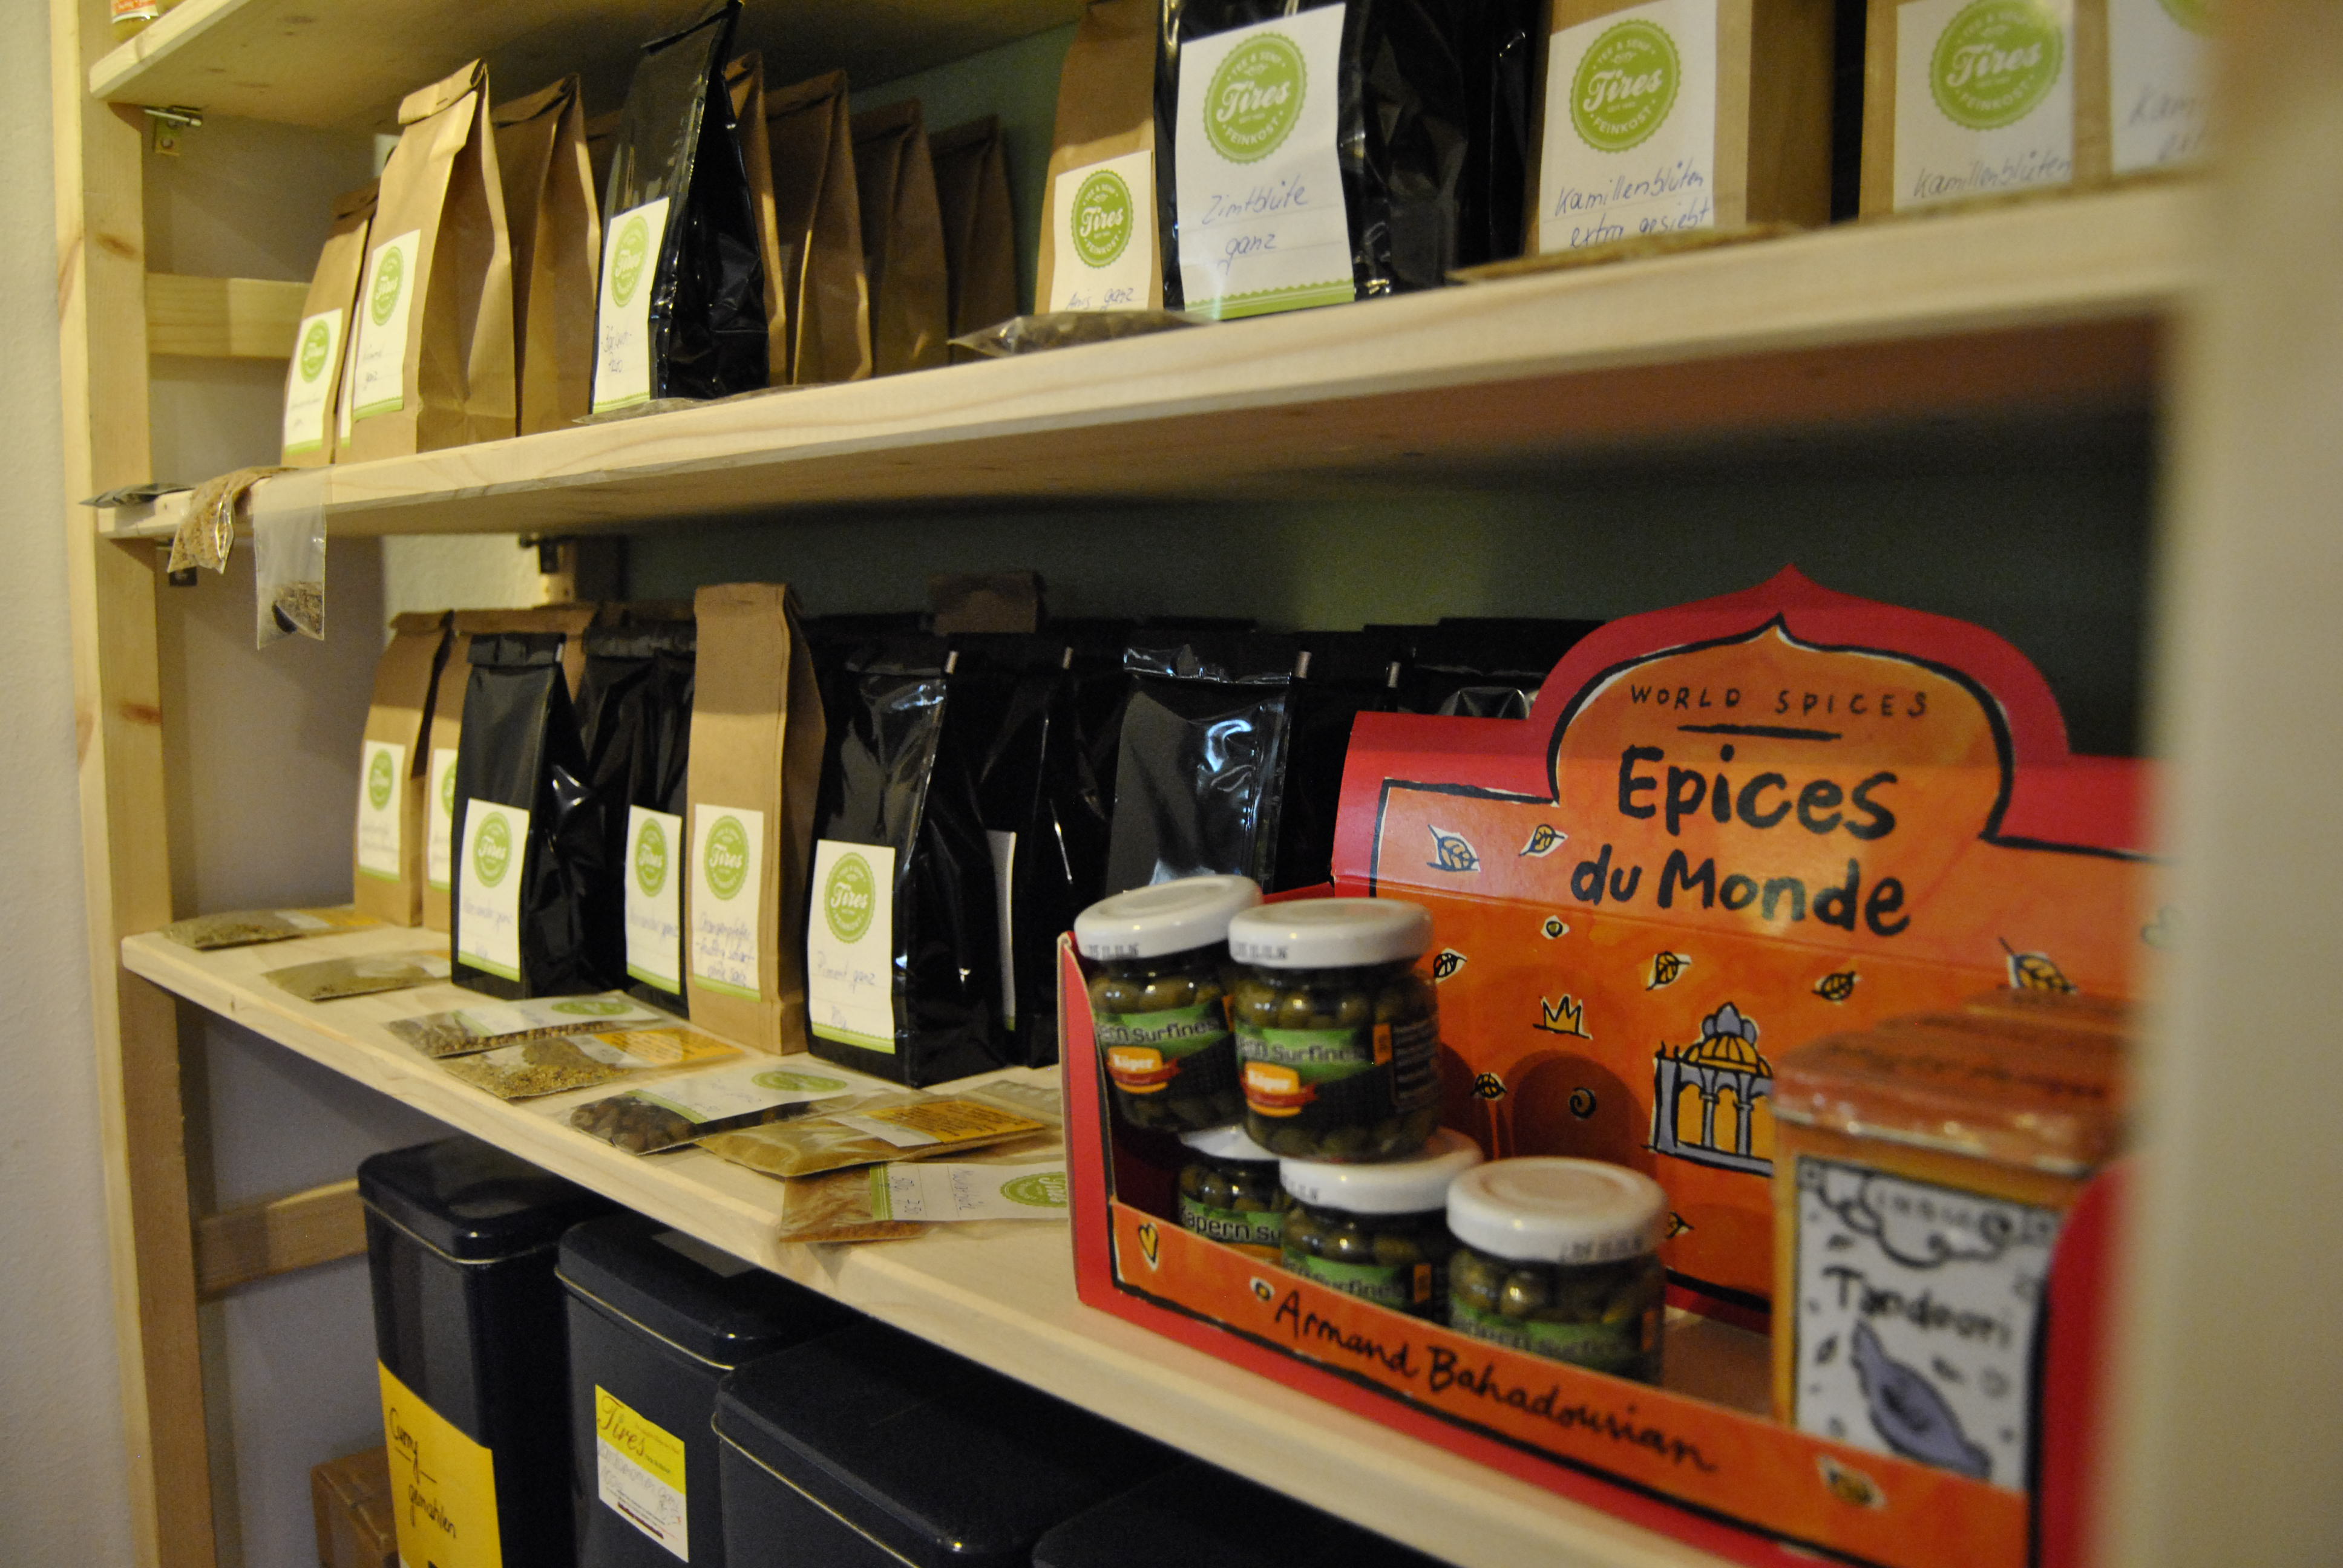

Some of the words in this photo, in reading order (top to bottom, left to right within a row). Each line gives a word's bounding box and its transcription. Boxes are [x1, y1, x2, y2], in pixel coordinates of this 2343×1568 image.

[1946, 42, 2042, 88] Tires
[1216, 79, 1291, 123] Tires
[1583, 68, 1663, 113] Tires
[1225, 116, 1279, 145] FEINKOST
[1593, 105, 1651, 134] FEINKOST
[1080, 206, 1124, 237] Tires
[1216, 233, 1277, 276] ganz
[1631, 684, 1742, 710] WORLD
[1774, 688, 1928, 717] SPICES
[1617, 743, 1898, 841] Epices
[708, 843, 743, 869] Tires
[830, 881, 869, 910] Tires
[1570, 844, 1642, 906] du
[1656, 848, 1910, 936] Monde
[1182, 1210, 1251, 1241] apern
[1274, 1290, 1420, 1379] Armand
[1427, 1342, 1718, 1472] Bahadourian
